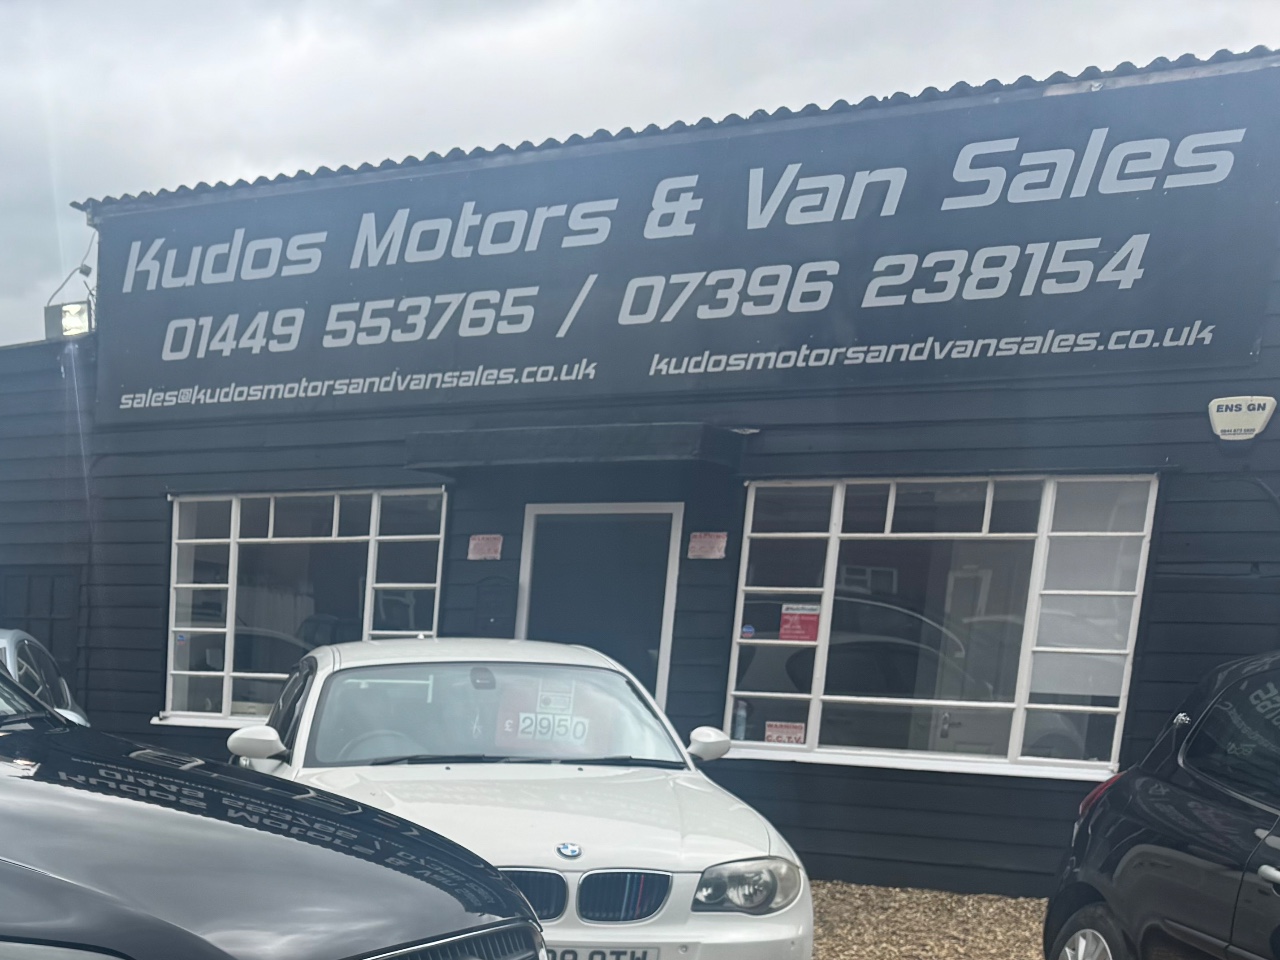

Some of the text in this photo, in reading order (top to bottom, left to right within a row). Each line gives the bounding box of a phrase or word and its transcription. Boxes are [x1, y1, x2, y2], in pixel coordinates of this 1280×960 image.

[122, 126, 1247, 293] Kudos Motors & Van Sales
[161, 233, 1151, 361] 01449 553765 / 07396 238154
[119, 358, 597, 409] sales@kudosmotorsandvansales.co.uk
[649, 319, 1217, 376] kudosmotorsandvansales.co.uk
